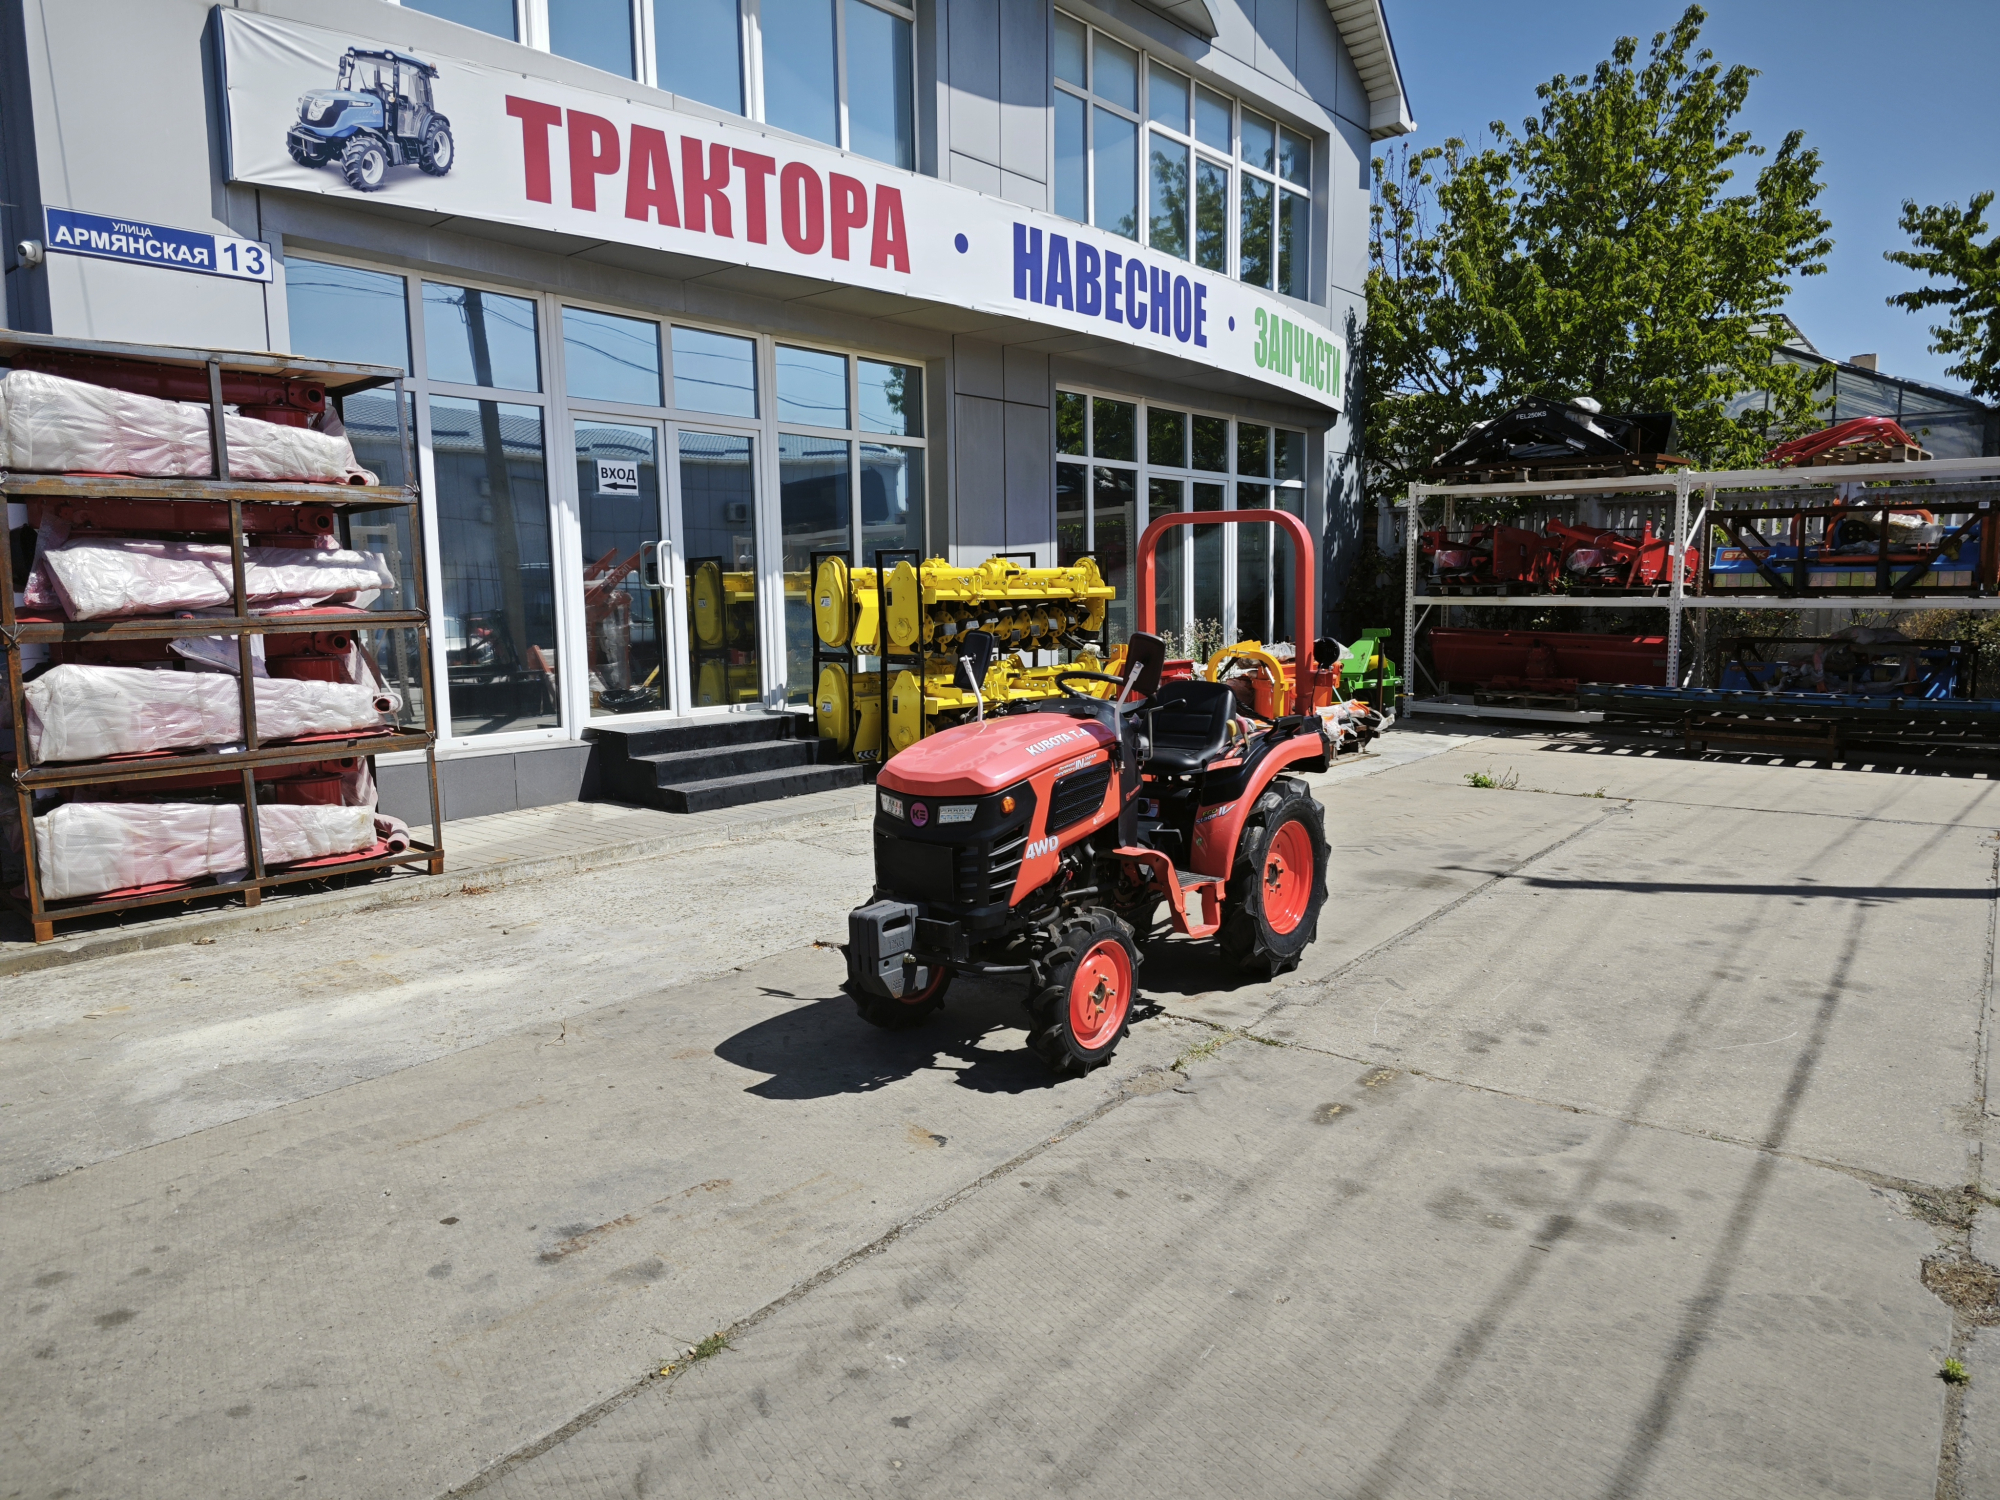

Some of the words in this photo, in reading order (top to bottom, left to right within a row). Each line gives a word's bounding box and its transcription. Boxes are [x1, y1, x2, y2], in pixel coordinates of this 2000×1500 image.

[112, 221, 153, 238] УЛИЦА
[55, 225, 209, 266] АРМЯНСКАЯ
[223, 242, 265, 275] 13
[505, 94, 911, 274] ТРАКТОРА
[1013, 221, 1208, 348] НАВЕСНОЕ
[1254, 307, 1341, 398] ЗАПЧАСТИ
[601, 466, 636, 483] ВХОД
[1723, 551, 1768, 560] STAK
[1025, 733, 1074, 757] KUBOTA
[1026, 835, 1058, 860] 4WD
